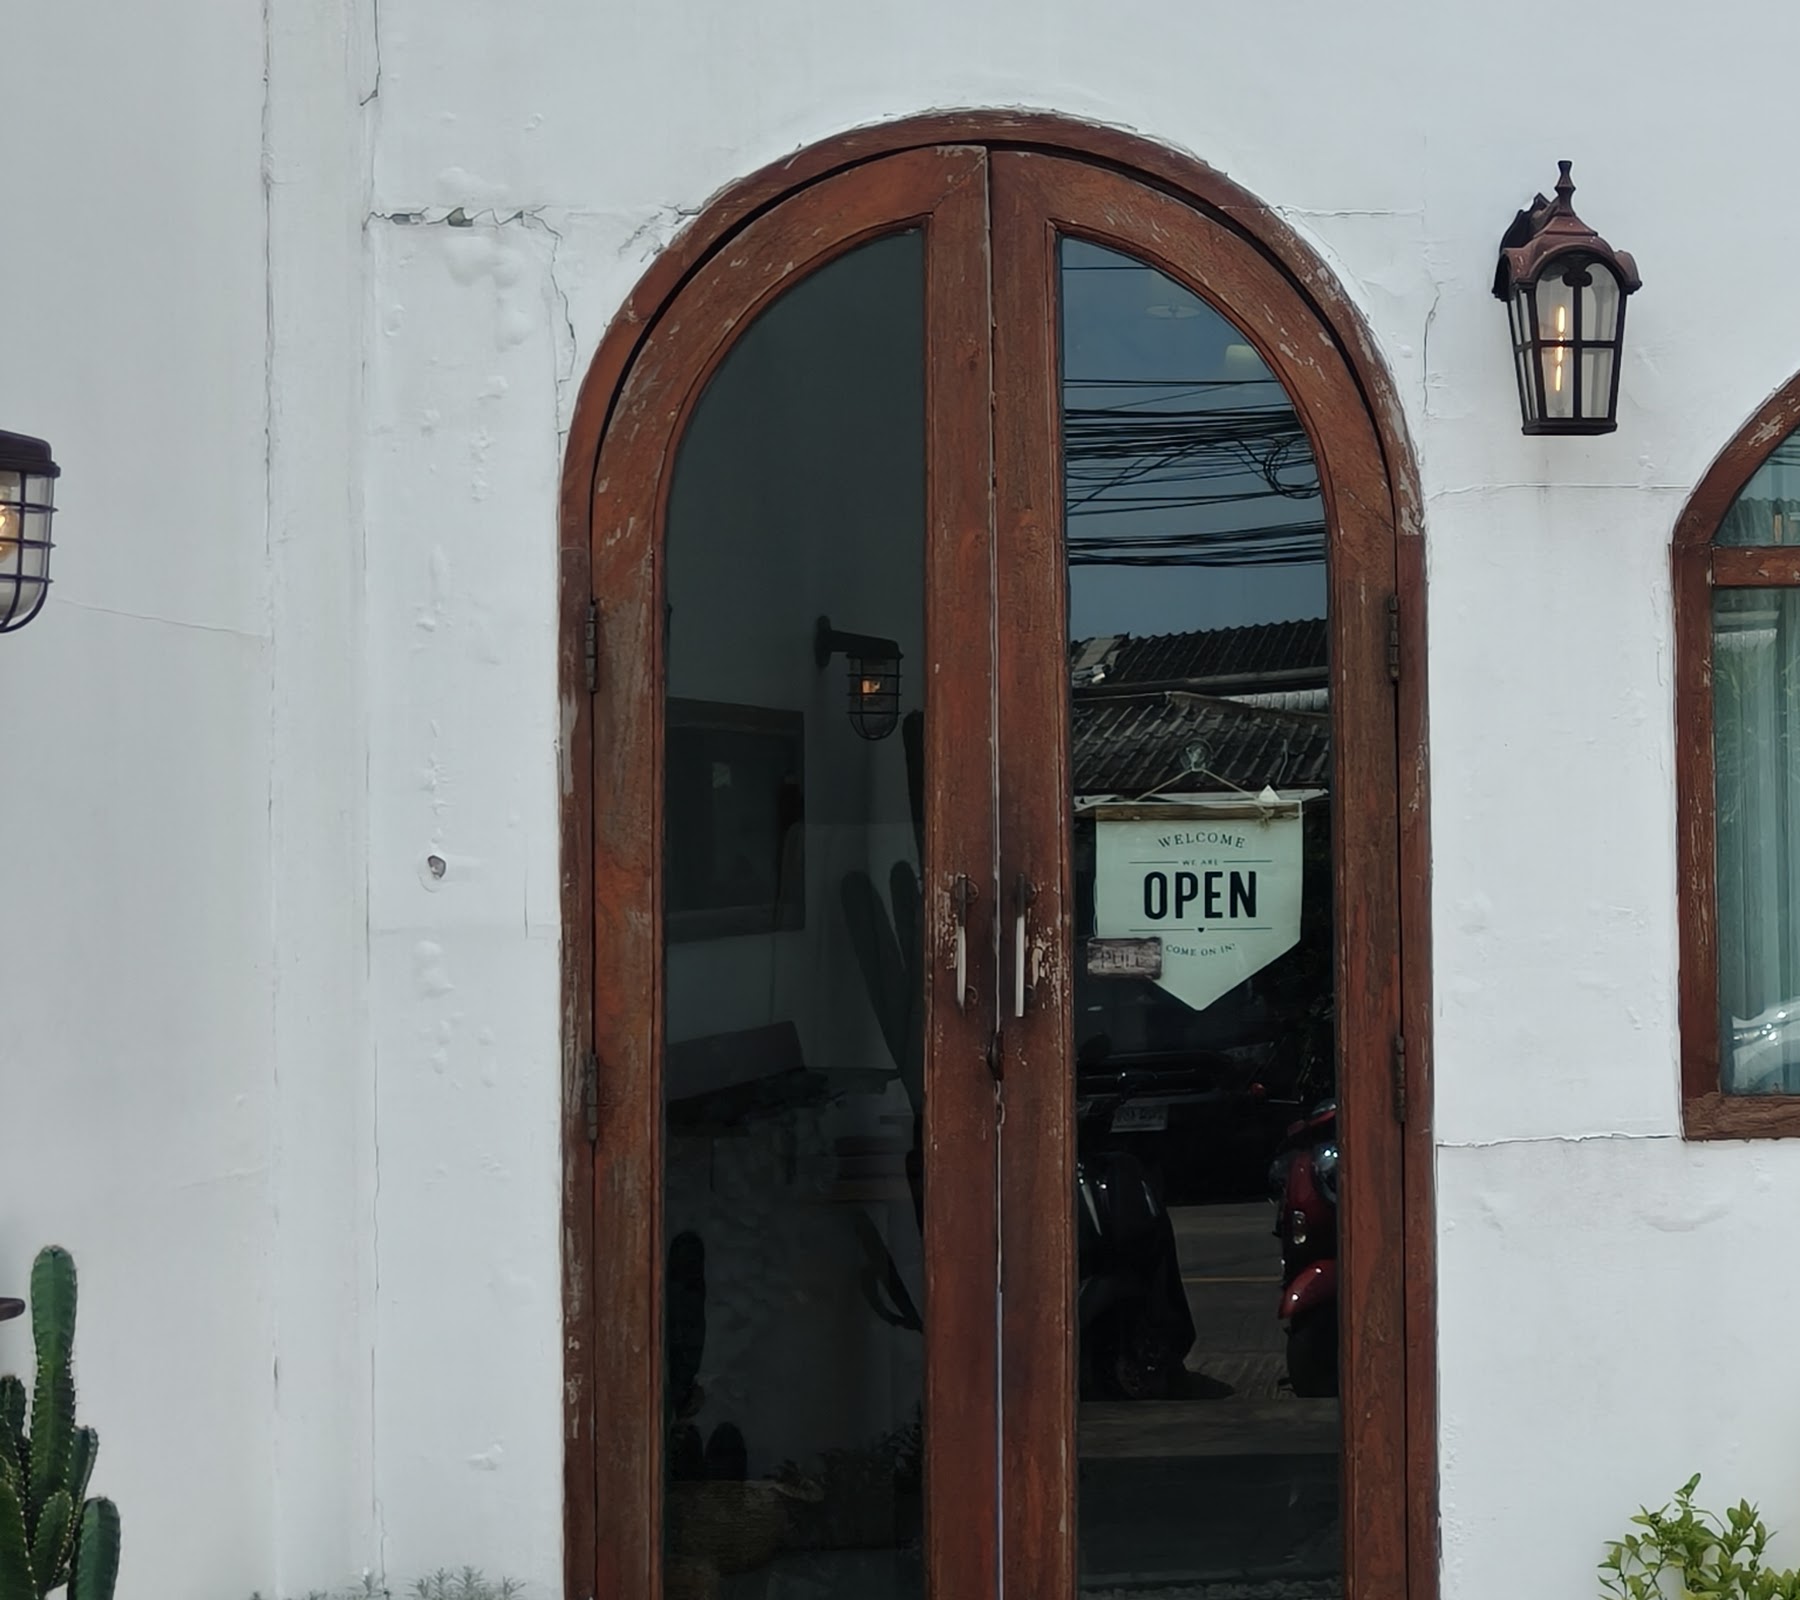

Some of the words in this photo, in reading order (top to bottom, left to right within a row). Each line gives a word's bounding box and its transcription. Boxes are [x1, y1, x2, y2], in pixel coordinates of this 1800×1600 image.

[1157, 831, 1246, 849] WELCOME
[1143, 870, 1257, 920] OPEN
[1165, 944, 1197, 957] COME
[1200, 947, 1217, 957] ON
